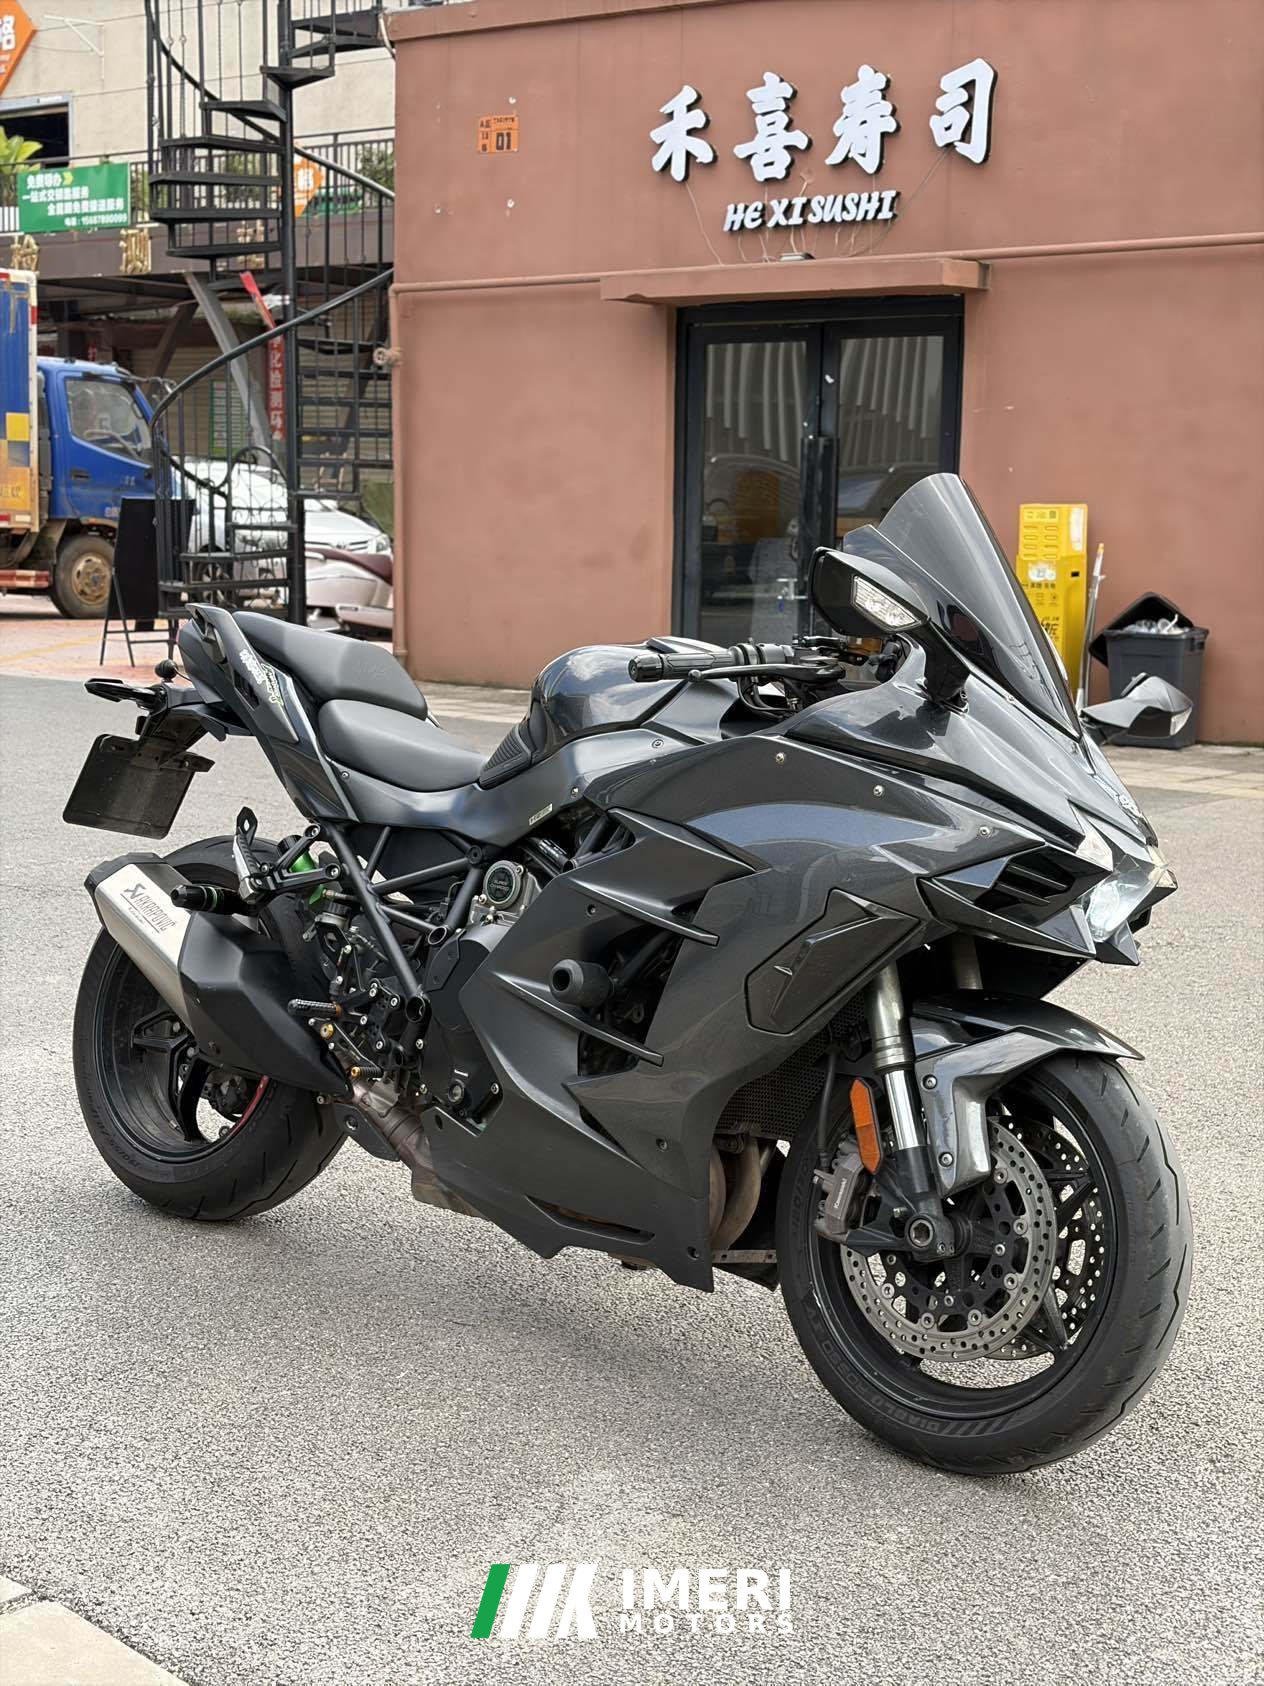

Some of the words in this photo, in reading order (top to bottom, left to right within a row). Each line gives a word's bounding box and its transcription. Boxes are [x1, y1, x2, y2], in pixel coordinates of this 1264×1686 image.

[496, 132, 511, 151] 01
[650, 58, 998, 183] 禾喜寿司
[723, 203, 763, 232] HE
[766, 197, 804, 228] XI
[807, 189, 898, 224] SUSHI
